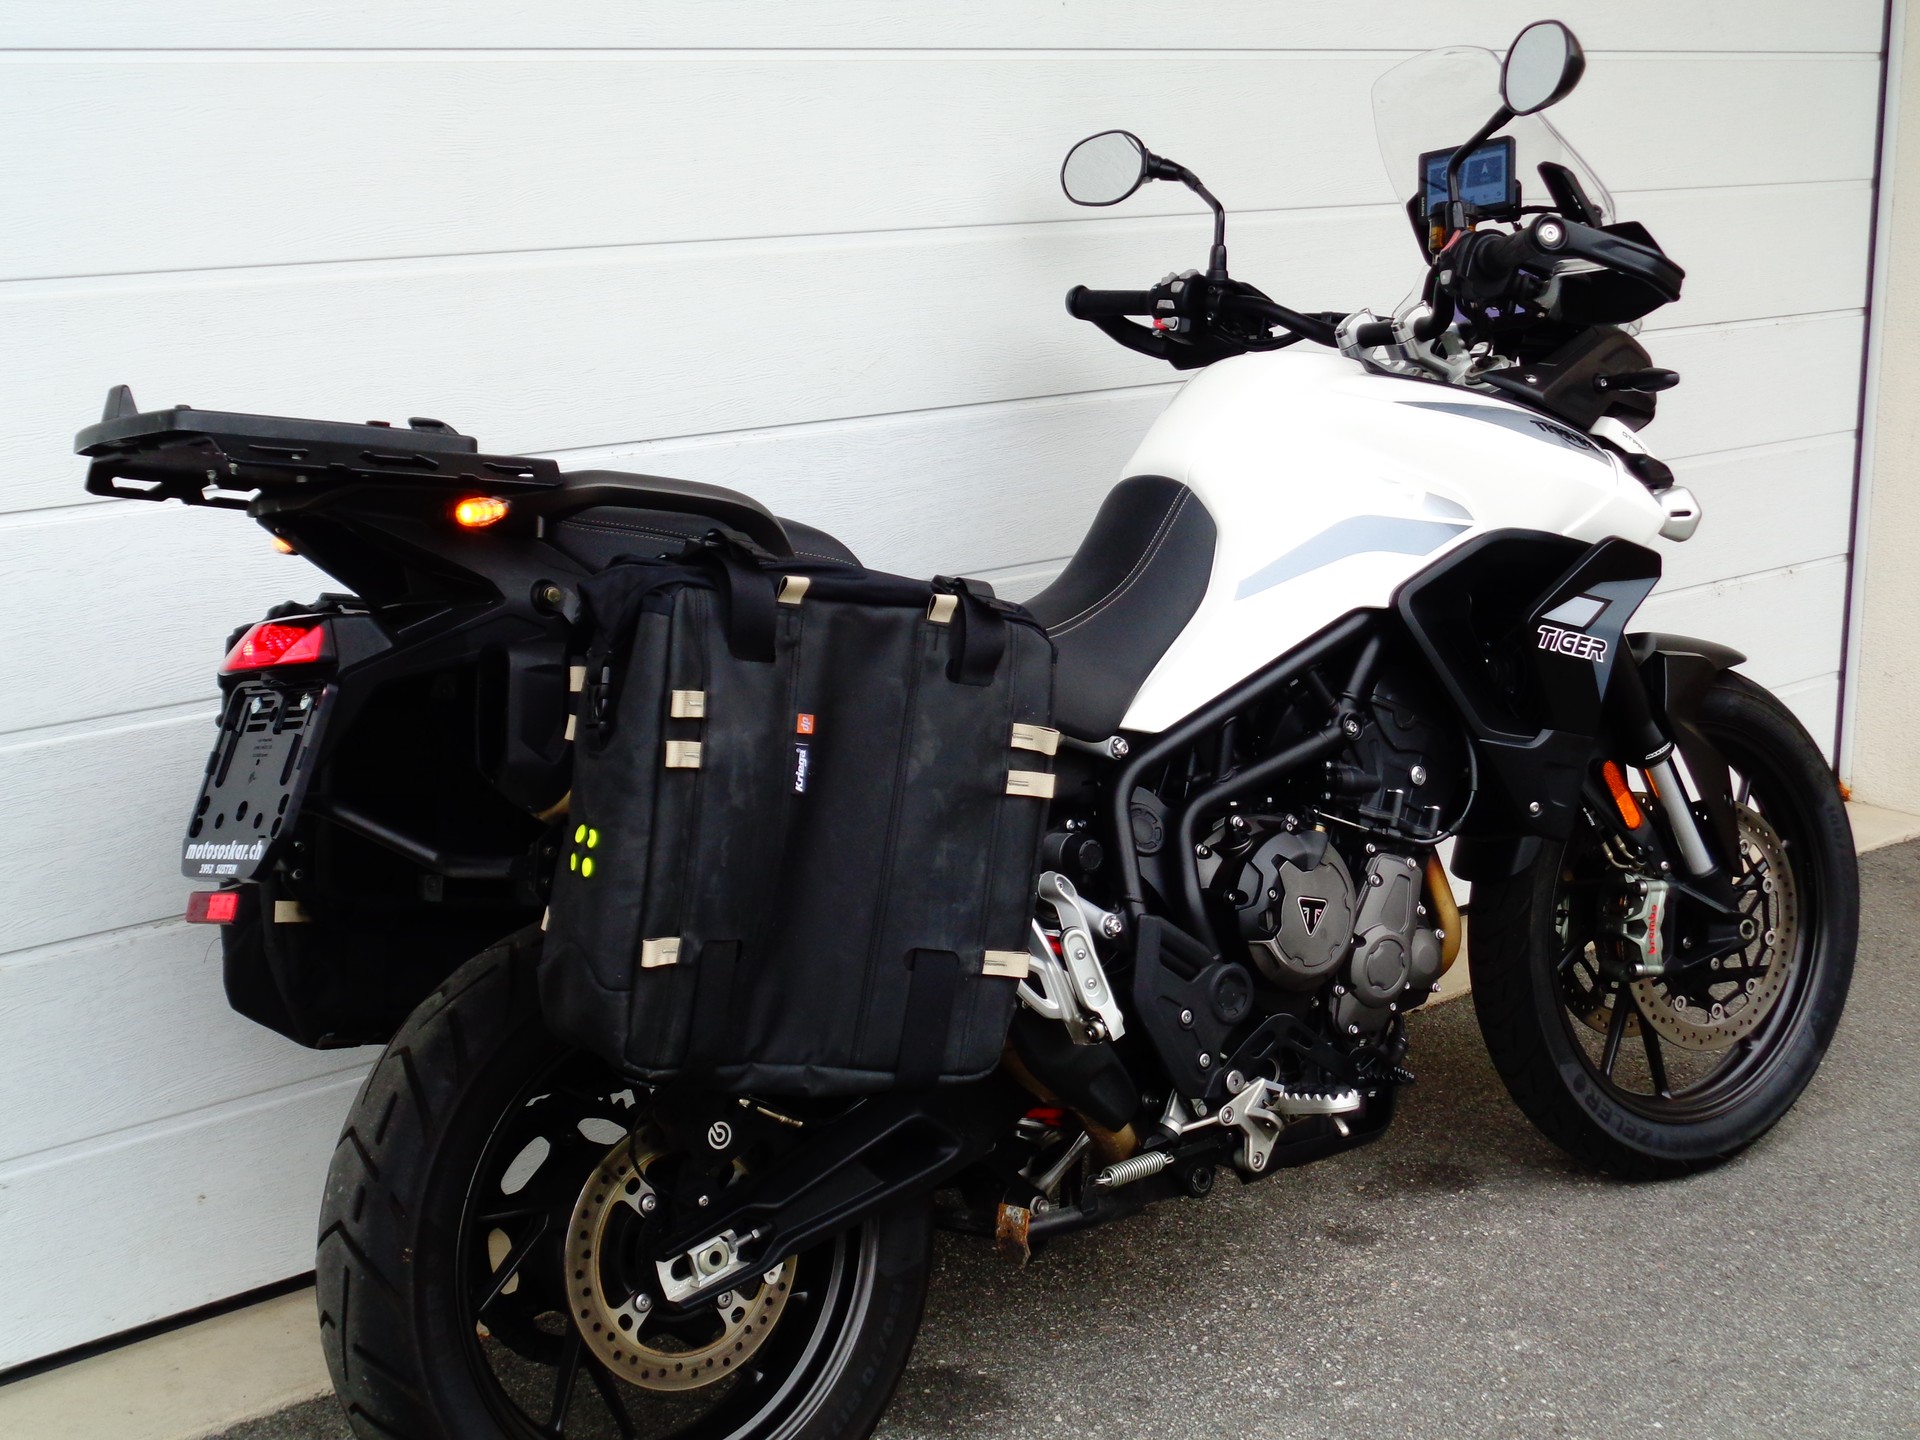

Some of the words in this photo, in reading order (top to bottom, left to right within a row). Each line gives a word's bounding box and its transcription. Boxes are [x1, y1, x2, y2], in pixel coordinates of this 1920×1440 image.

[1537, 625, 1608, 663] TIGER
[795, 748, 807, 792] Kriega
[185, 840, 263, 860] motososkar.ch
[198, 864, 214, 874] 3952
[215, 864, 238, 875] SUSTEN
[1648, 904, 1658, 955] brembo
